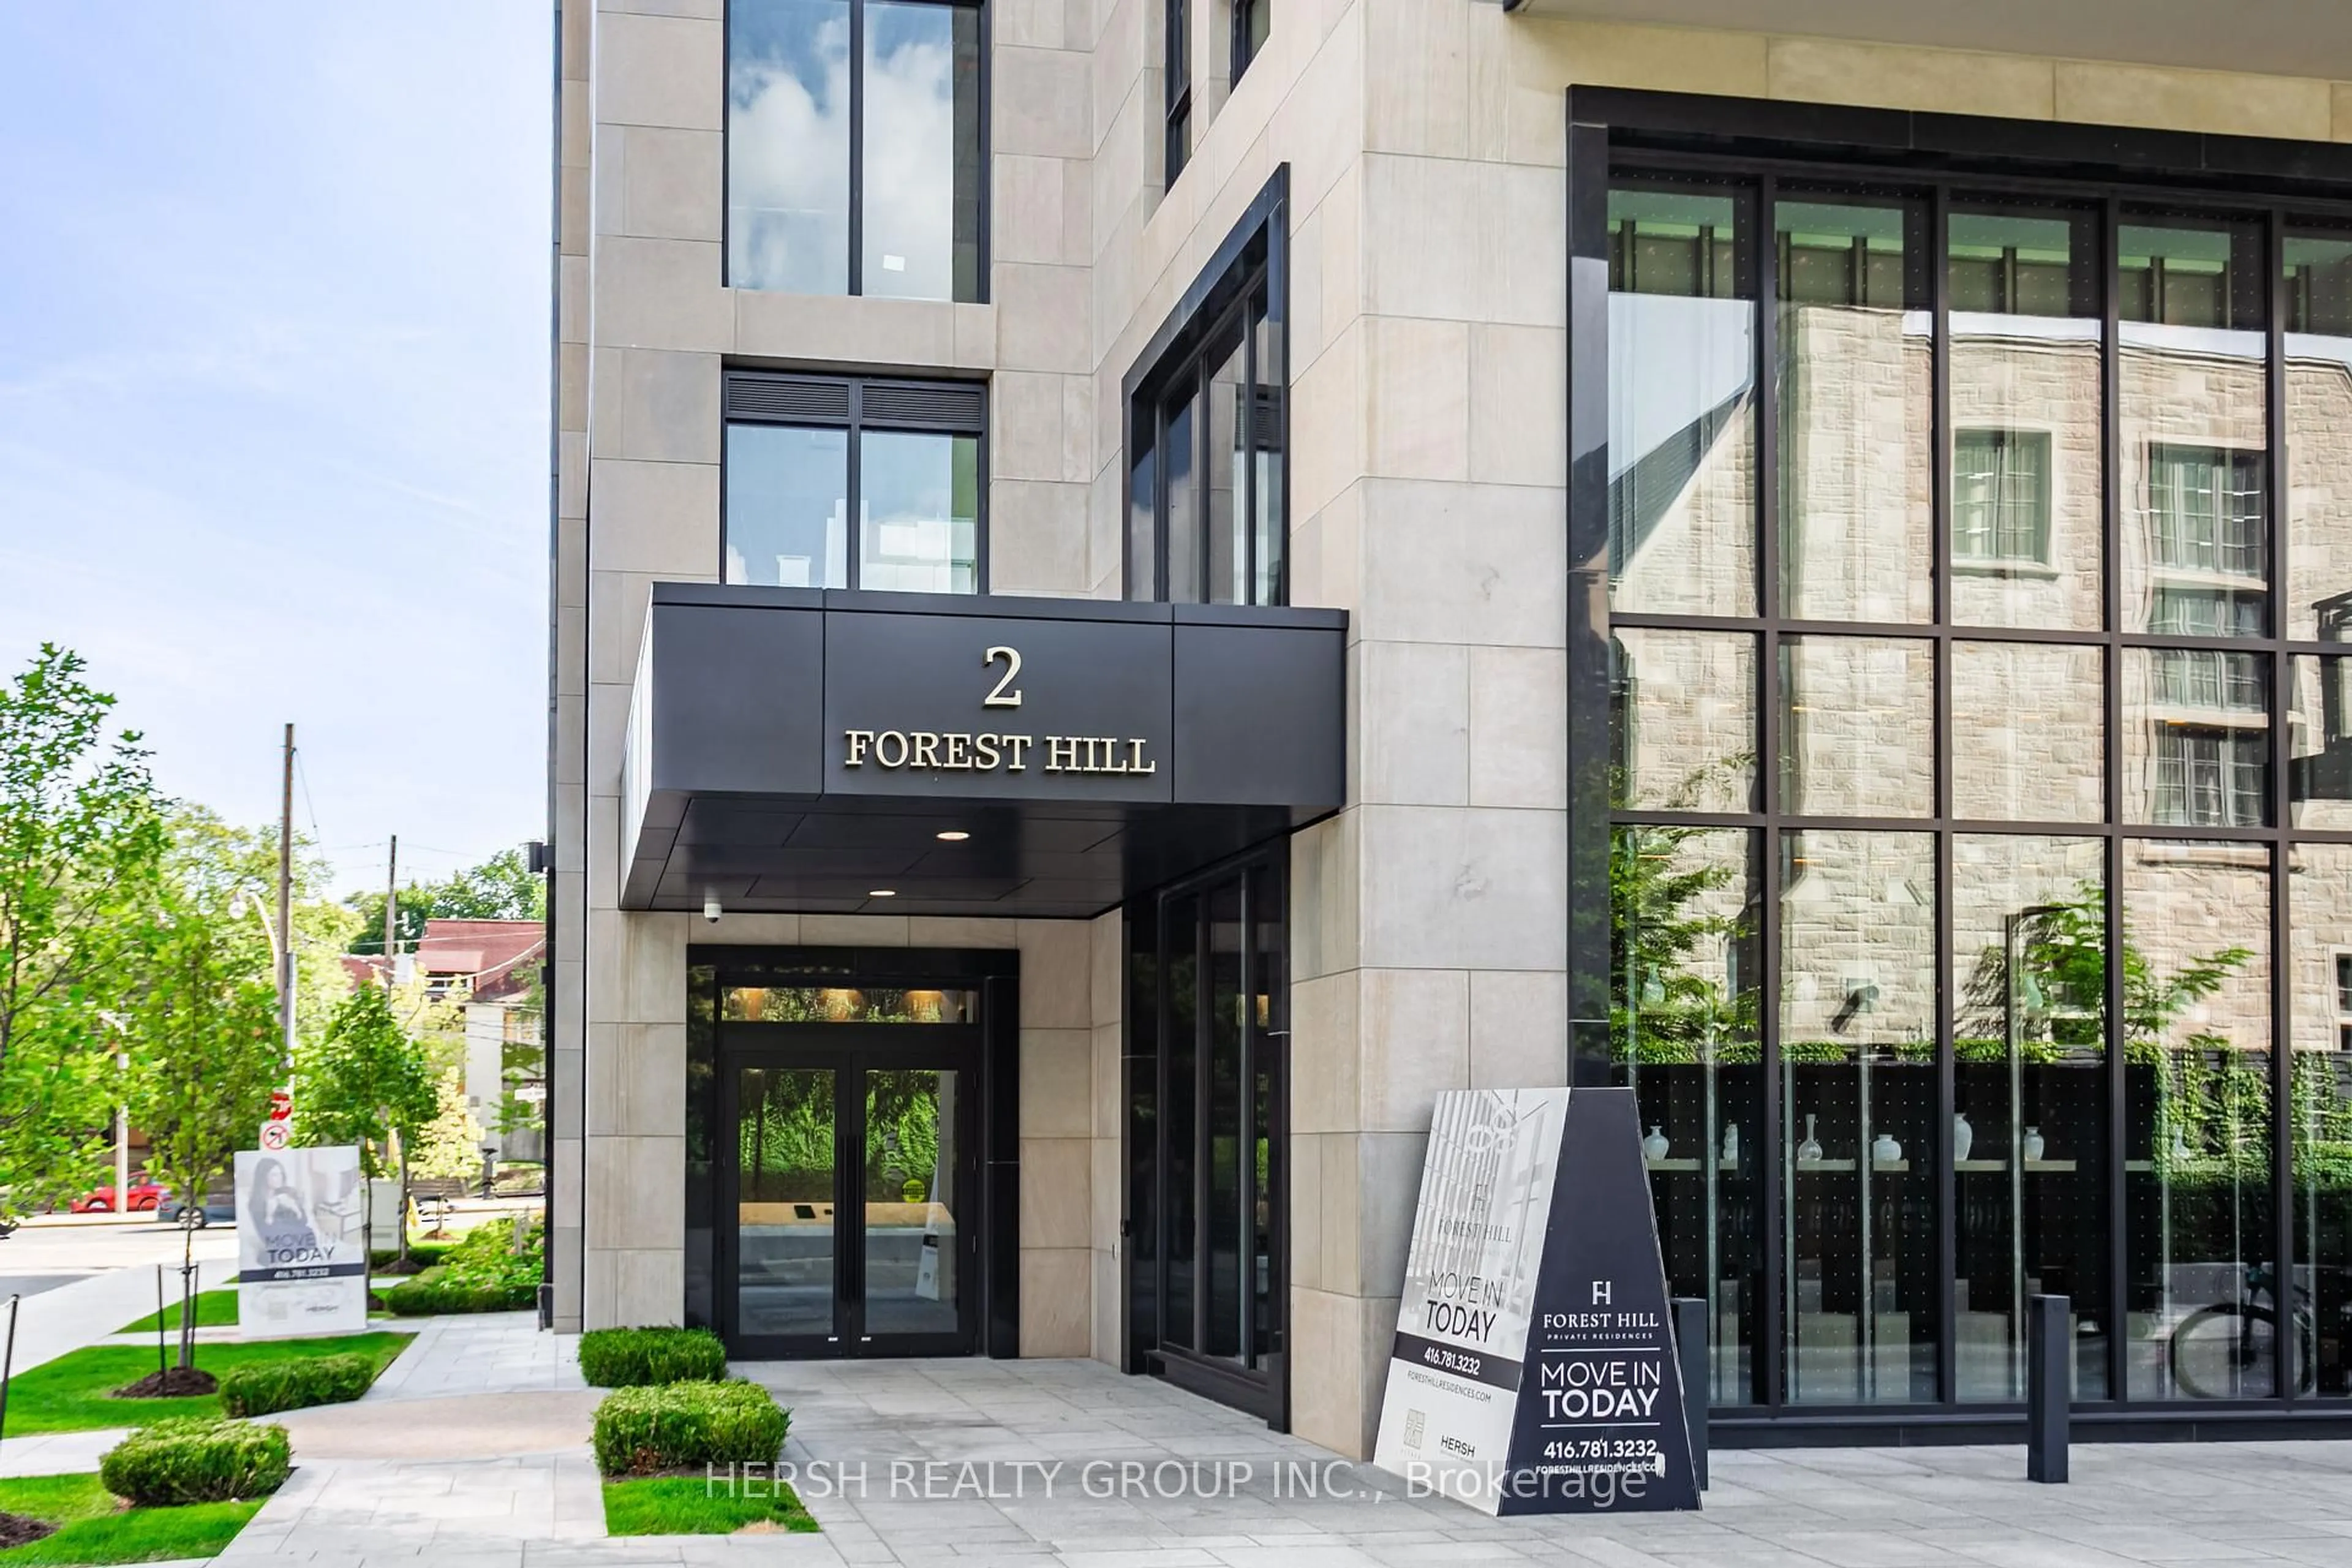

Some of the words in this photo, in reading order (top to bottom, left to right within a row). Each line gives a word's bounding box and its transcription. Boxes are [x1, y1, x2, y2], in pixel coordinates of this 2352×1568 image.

[983, 646, 1022, 707] 2
[845, 729, 1033, 771] FOREST
[1044, 736, 1156, 774] HILL
[1438, 1217, 1480, 1238] FOREST
[1483, 1224, 1512, 1243] HILL
[266, 1246, 334, 1263] TODAY
[1428, 1269, 1481, 1304] MOVE
[1482, 1278, 1504, 1308] IN
[1427, 1299, 1496, 1343] TODAY
[1544, 1314, 1611, 1329] FOREST
[1618, 1313, 1659, 1327] HILL
[1424, 1346, 1480, 1376] 416.781.3232
[1541, 1361, 1626, 1387] MOVE
[1634, 1361, 1660, 1385] IN
[1542, 1388, 1660, 1418] TODAY
[1440, 1434, 1476, 1458] HERSH
[1544, 1439, 1657, 1459] 416.781.3232
